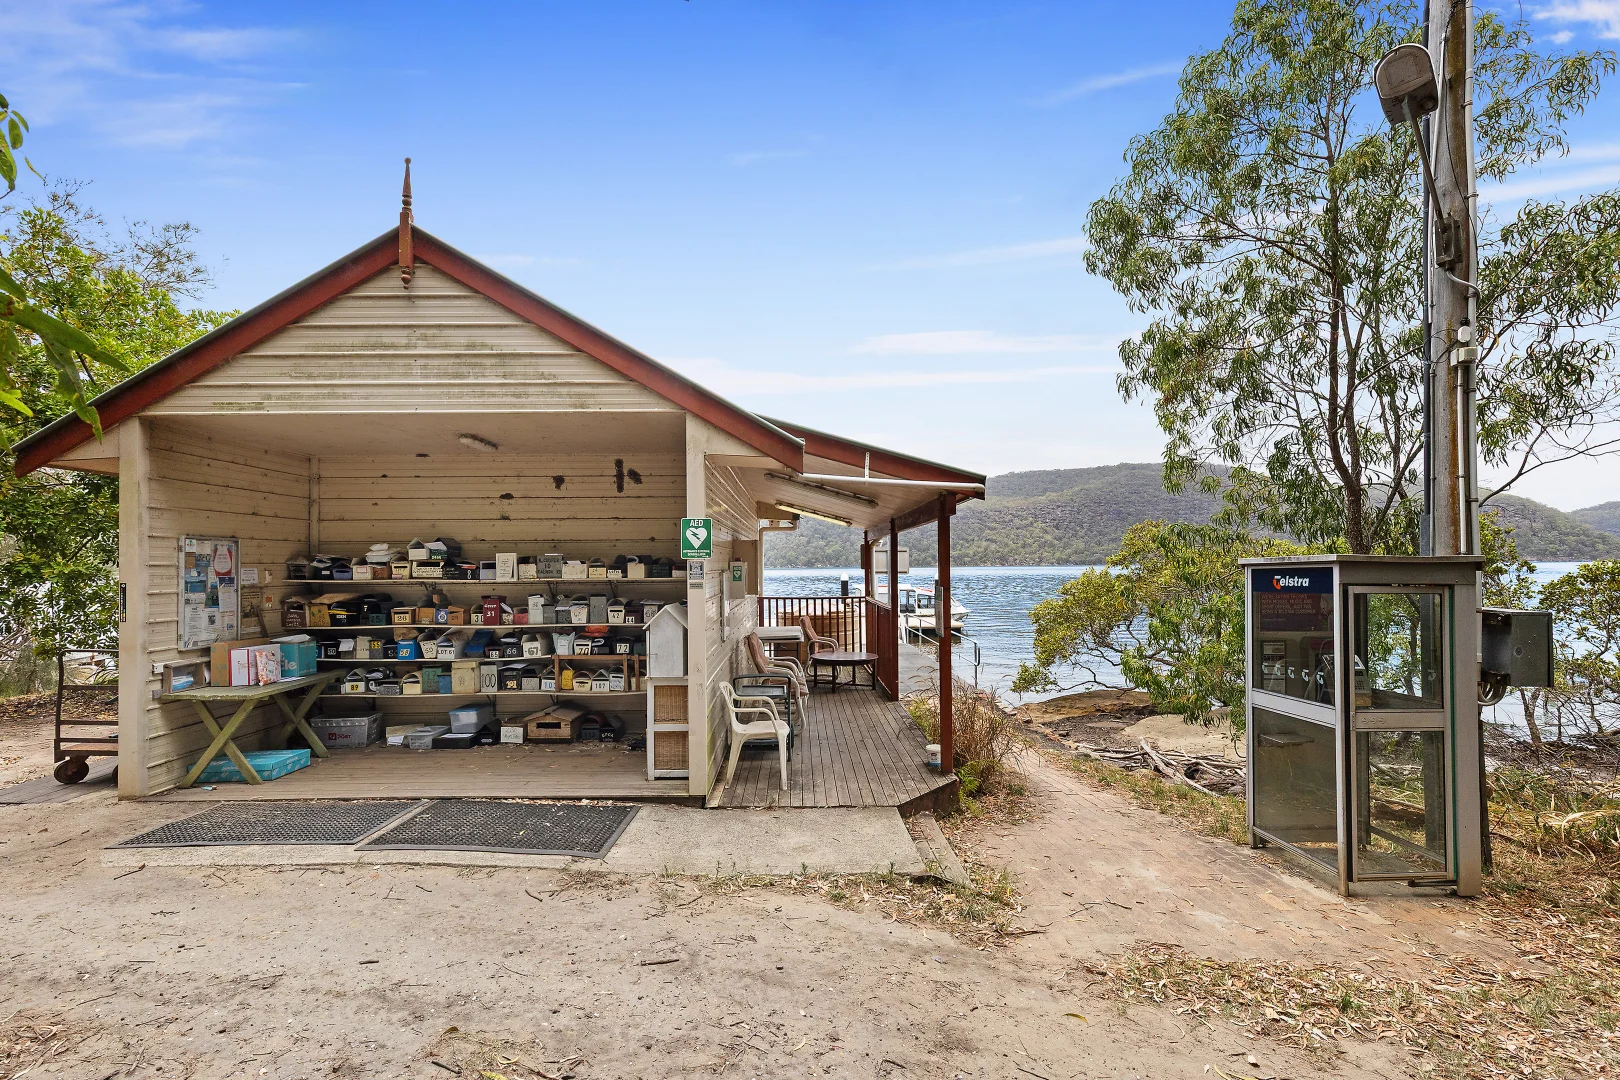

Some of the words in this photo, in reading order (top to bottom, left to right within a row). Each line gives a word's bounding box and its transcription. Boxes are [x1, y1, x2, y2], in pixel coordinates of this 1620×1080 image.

[1272, 576, 1310, 590] Telstra
[618, 644, 628, 652] 72
[482, 674, 496, 688] 100
